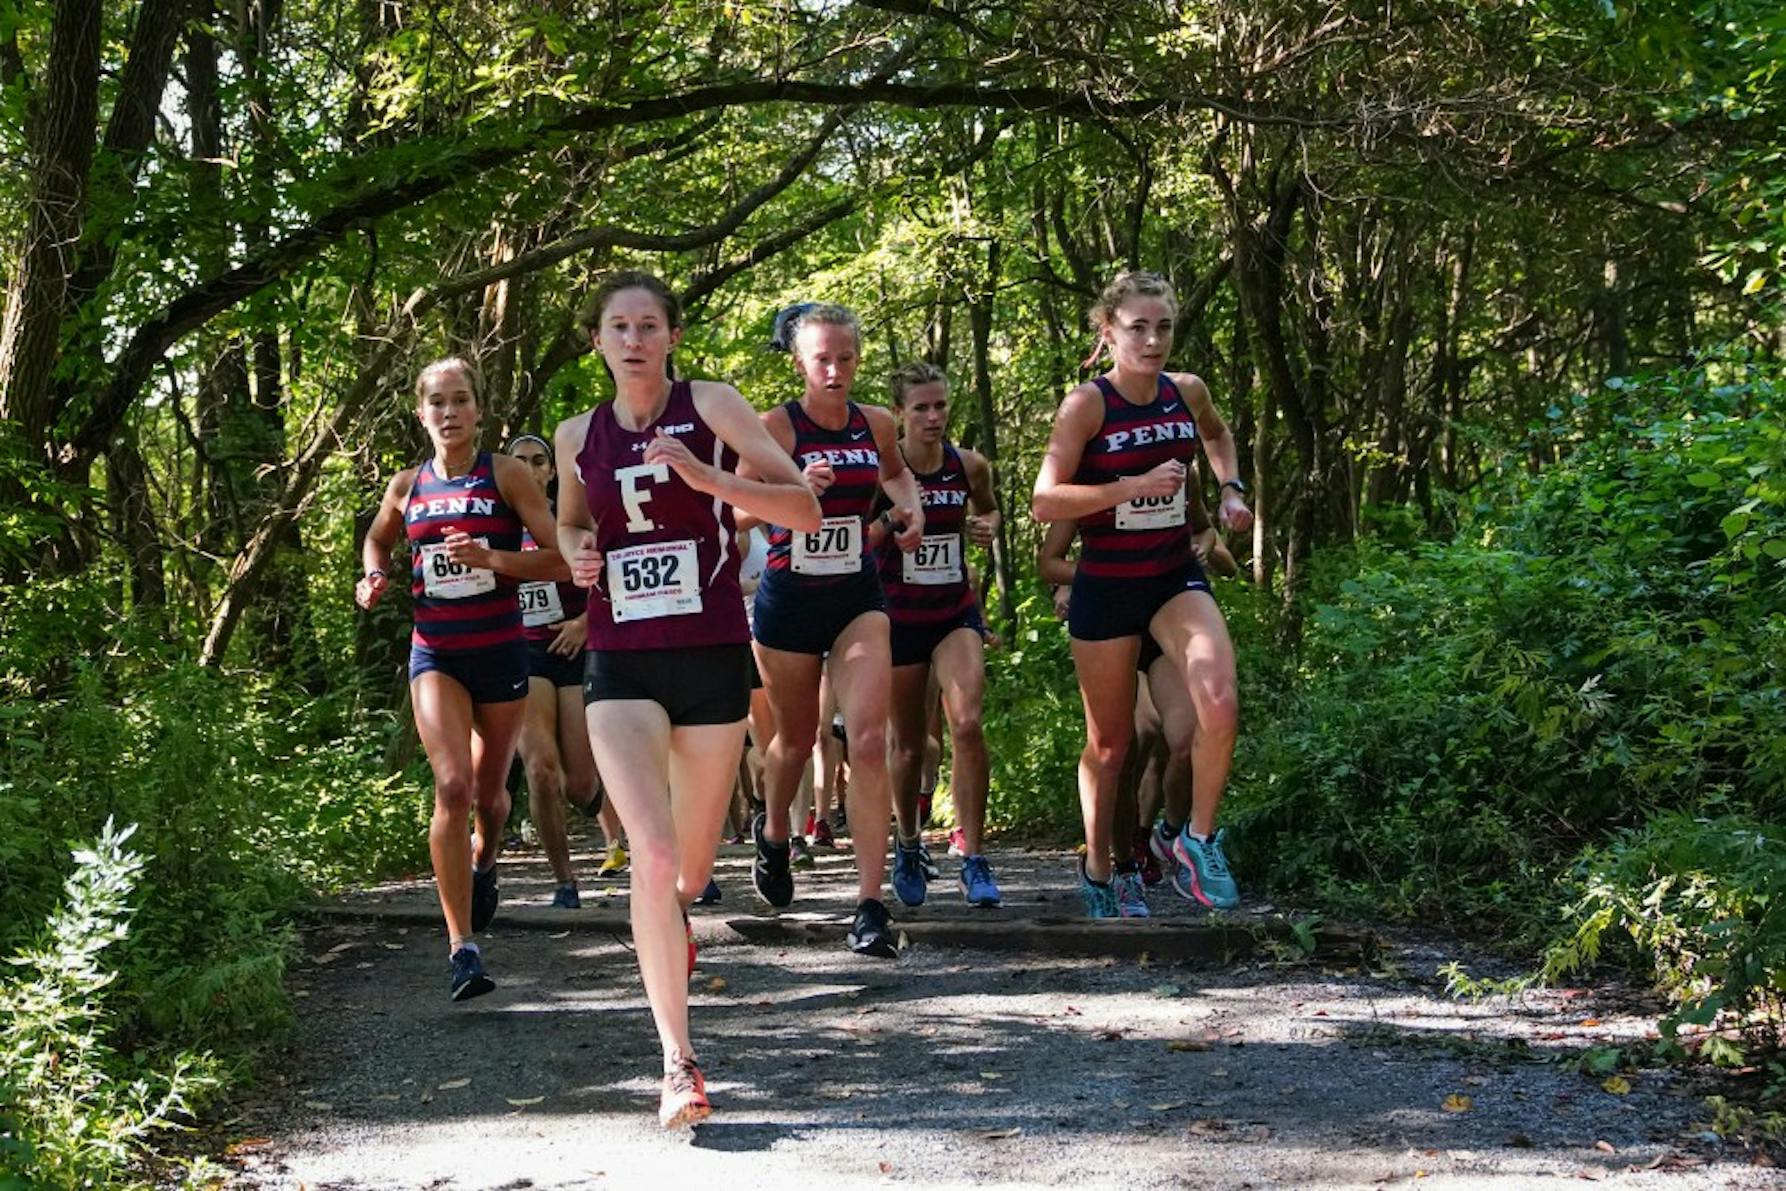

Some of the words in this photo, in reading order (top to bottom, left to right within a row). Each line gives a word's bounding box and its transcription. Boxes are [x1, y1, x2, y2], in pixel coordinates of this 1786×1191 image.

[1105, 421, 1195, 453] PENN
[408, 497, 496, 521] PENN
[614, 463, 670, 533] F
[920, 489, 967, 506] ENN
[805, 527, 849, 553] 670
[433, 553, 472, 577] 66
[915, 542, 949, 566] 671
[622, 554, 681, 592] 532
[518, 589, 549, 610] 679
